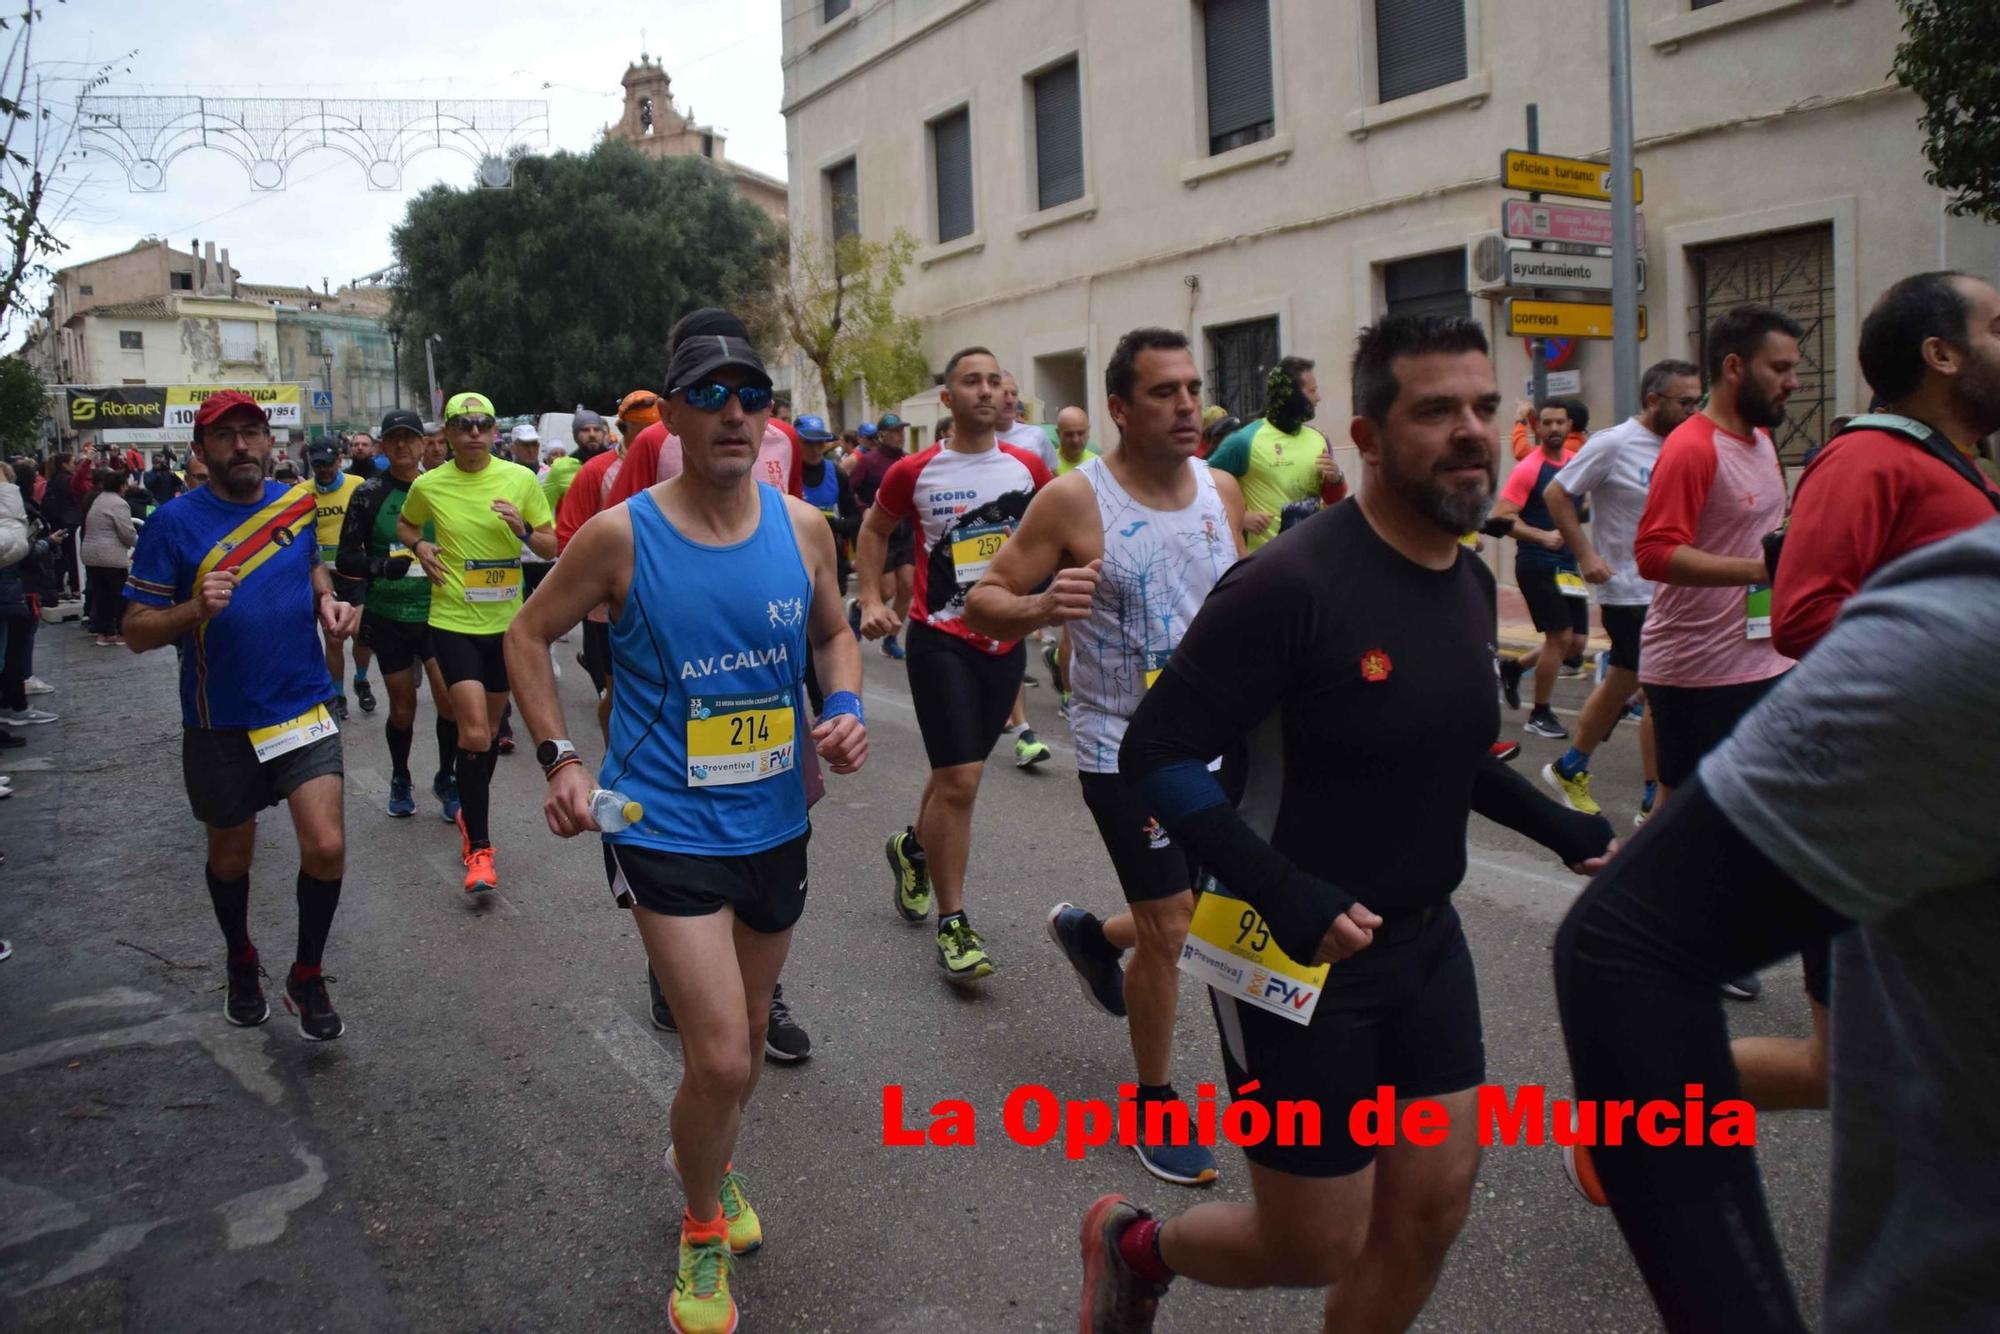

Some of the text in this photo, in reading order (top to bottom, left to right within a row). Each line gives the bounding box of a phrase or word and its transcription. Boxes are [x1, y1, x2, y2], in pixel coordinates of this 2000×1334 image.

[1513, 159, 1595, 181] oficina turismo
[1513, 262, 1591, 279] ayuntamiento
[1514, 313, 1559, 325] correos
[190, 390, 212, 402] FIB
[100, 400, 161, 416] fibranet
[765, 461, 781, 474] 33
[932, 504, 967, 516] MRW
[486, 570, 505, 584] 209
[681, 657, 718, 679] A.V.
[731, 714, 769, 746] 214
[702, 762, 751, 772] Preventiva
[1236, 909, 1270, 952] 95
[1194, 949, 1238, 977] Preventiva
